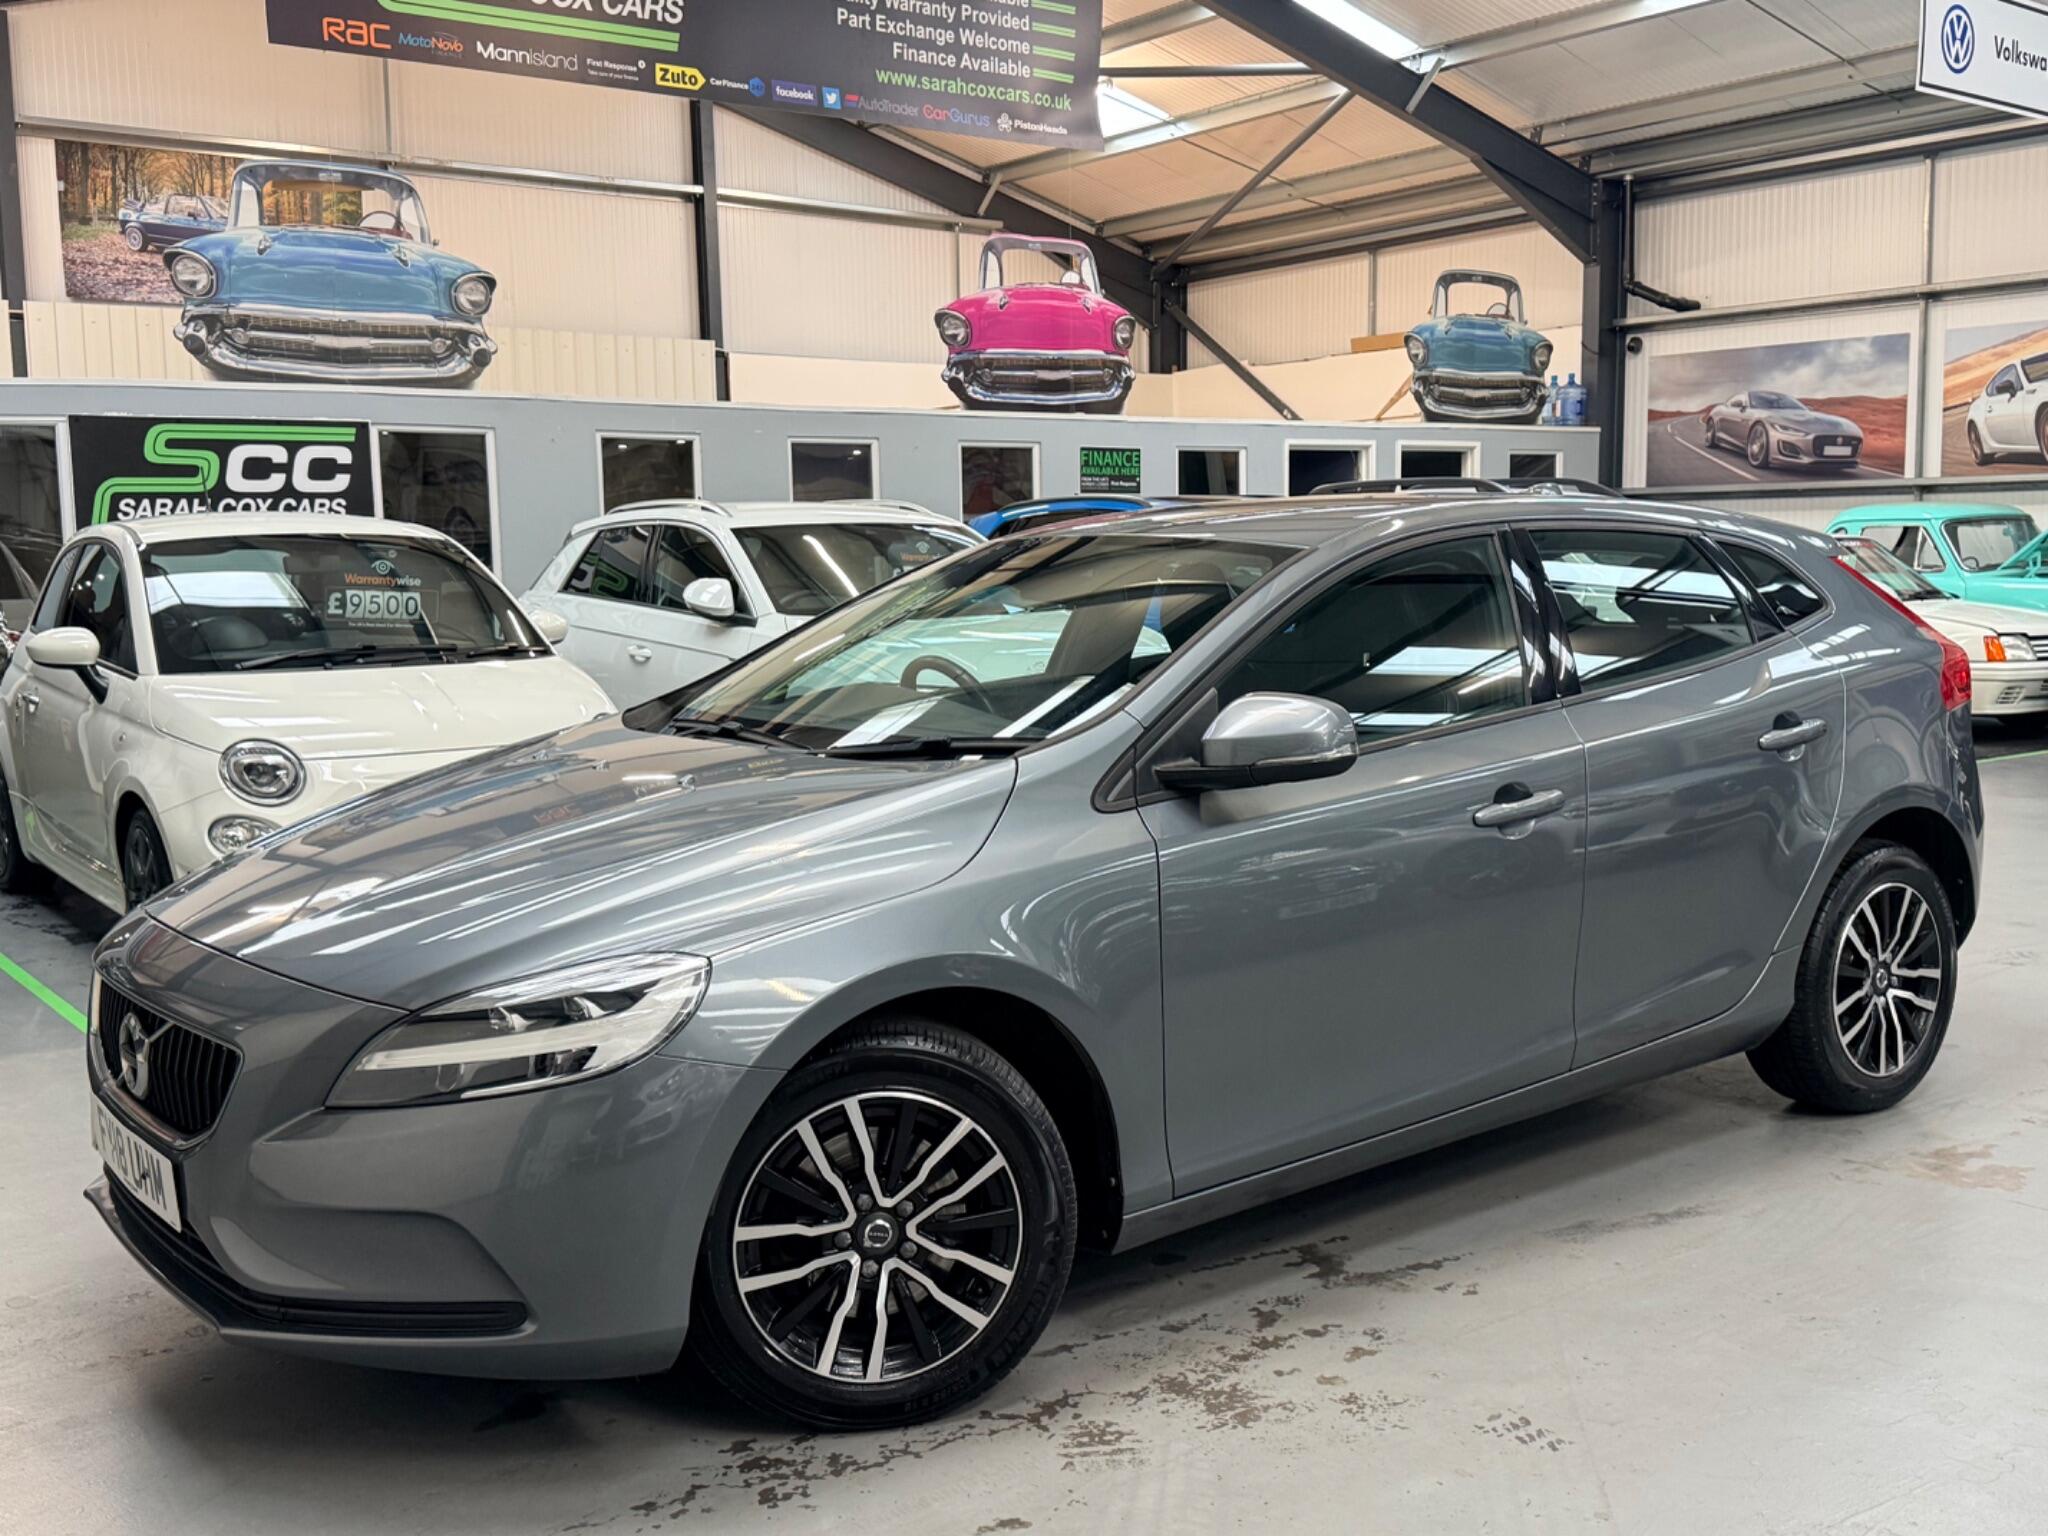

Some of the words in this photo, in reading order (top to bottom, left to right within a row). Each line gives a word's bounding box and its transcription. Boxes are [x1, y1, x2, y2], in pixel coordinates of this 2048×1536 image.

[961, 4, 1030, 32] Provided
[399, 32, 464, 52] MotoNovo
[837, 7, 871, 30] Part
[875, 15, 955, 45] Exchange
[959, 27, 1031, 55] Welcome
[892, 42, 956, 67] Finance
[960, 52, 1031, 78] Available
[659, 67, 698, 86] Zuto
[776, 86, 814, 100] facebook
[875, 69, 1072, 111] www.sarahcoxcars.co.uk
[922, 104, 991, 127] CarGurus
[1080, 450, 1140, 467] FINANCE
[344, 573, 422, 587] Warrantywise
[327, 591, 420, 617] £9500
